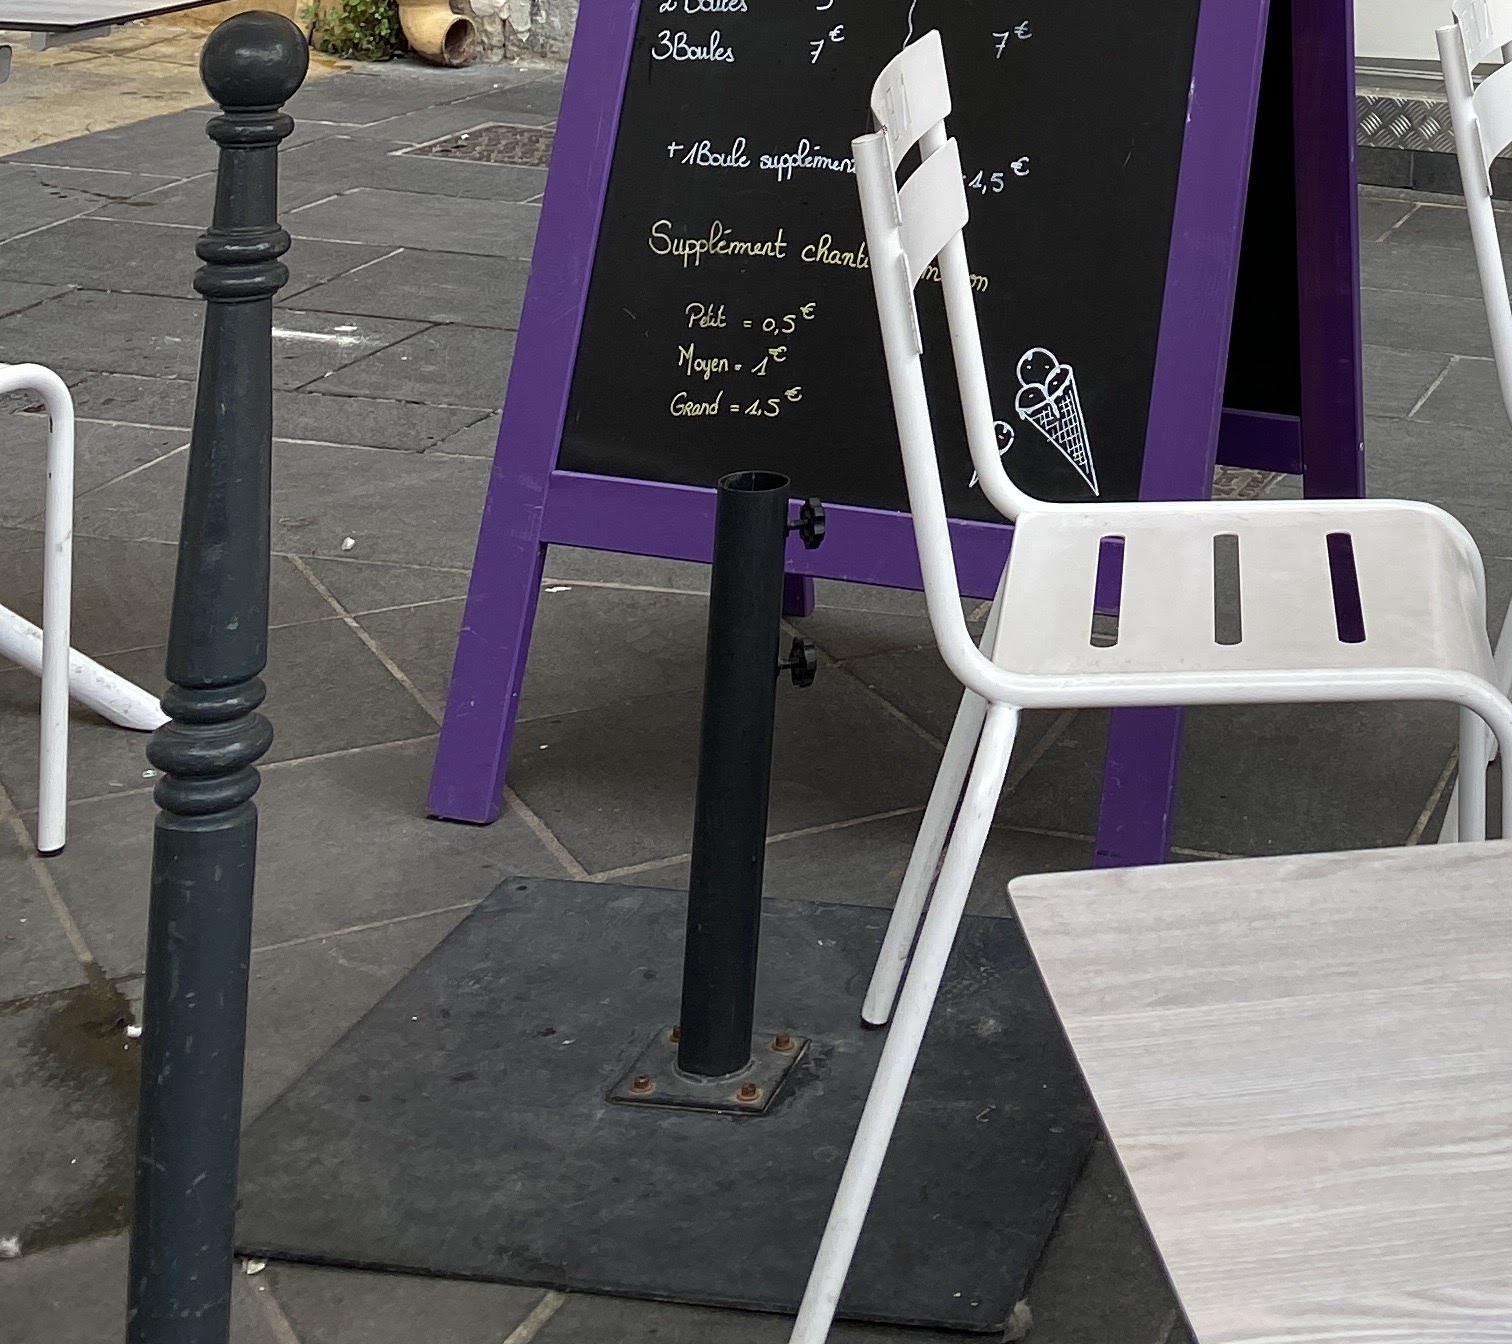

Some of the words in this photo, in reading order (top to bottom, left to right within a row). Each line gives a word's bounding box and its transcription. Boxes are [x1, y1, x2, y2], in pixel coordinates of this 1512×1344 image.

[649, 219, 787, 269] Supplément
[685, 302, 727, 328] Petit
[678, 343, 729, 380] Moyen
